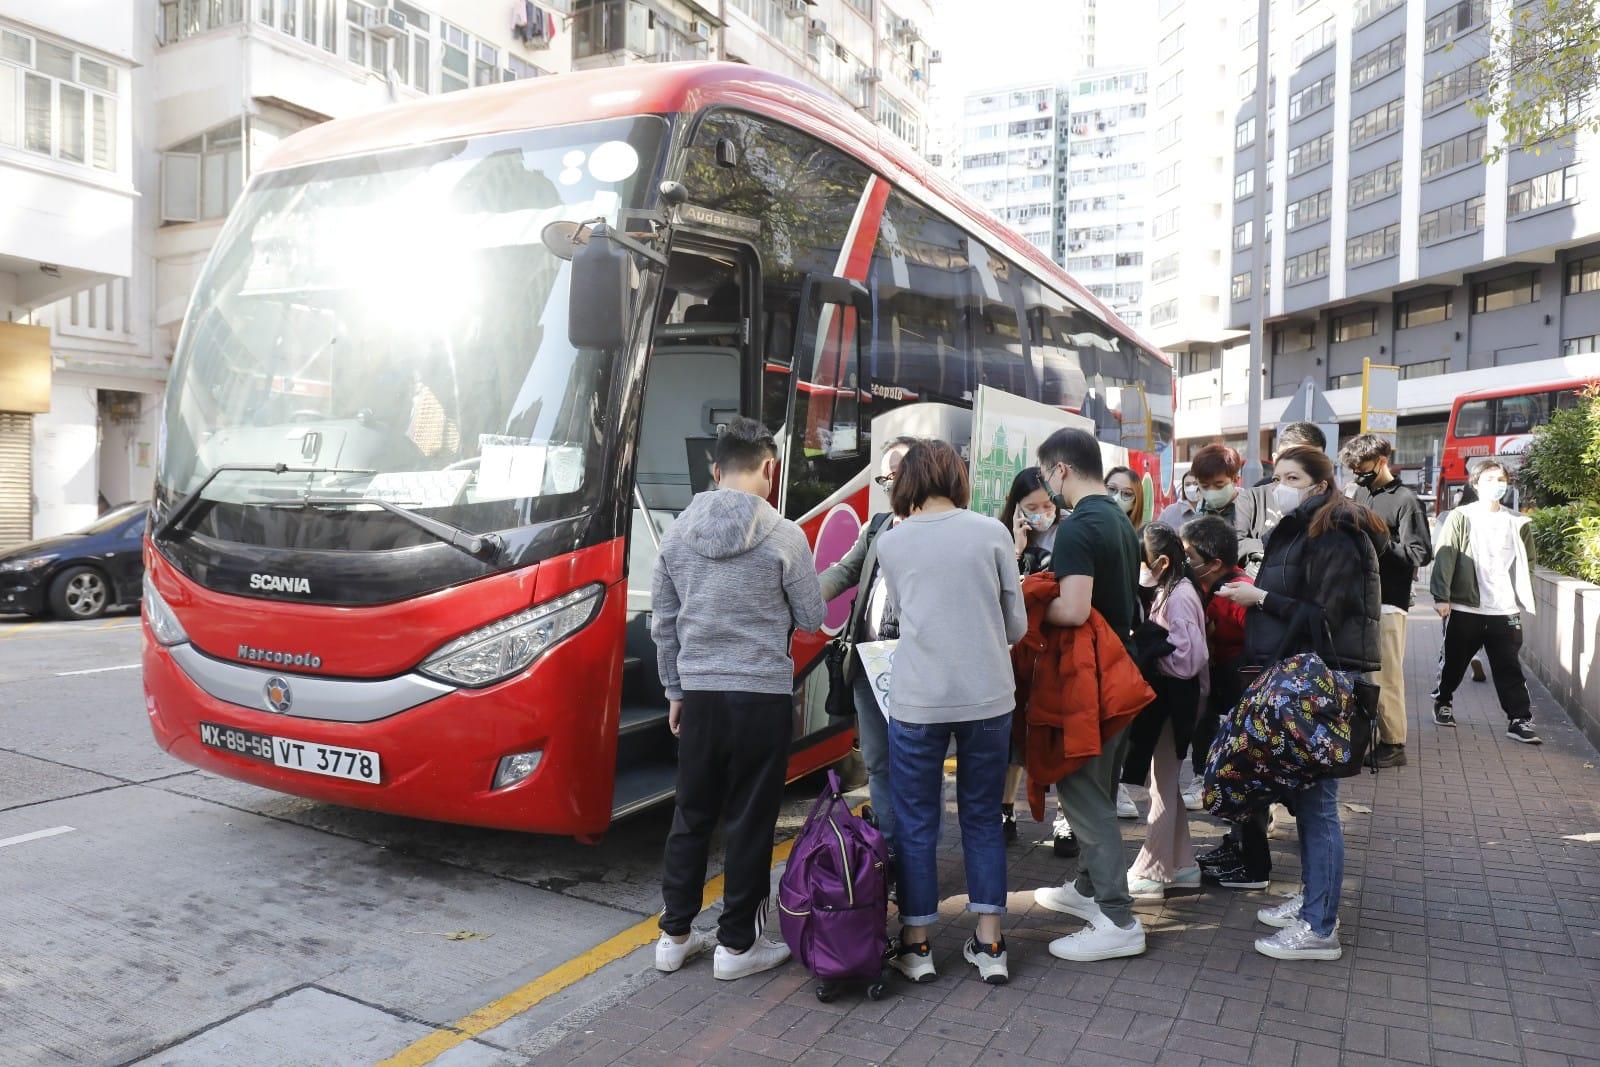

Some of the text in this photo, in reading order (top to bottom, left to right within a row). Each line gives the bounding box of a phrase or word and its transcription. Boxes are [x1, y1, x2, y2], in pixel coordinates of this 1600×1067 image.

[249, 573, 311, 594] SCANIA
[238, 644, 322, 668] Marcopolo
[200, 724, 273, 759] MX-89-56
[279, 741, 373, 778] VT 3778
